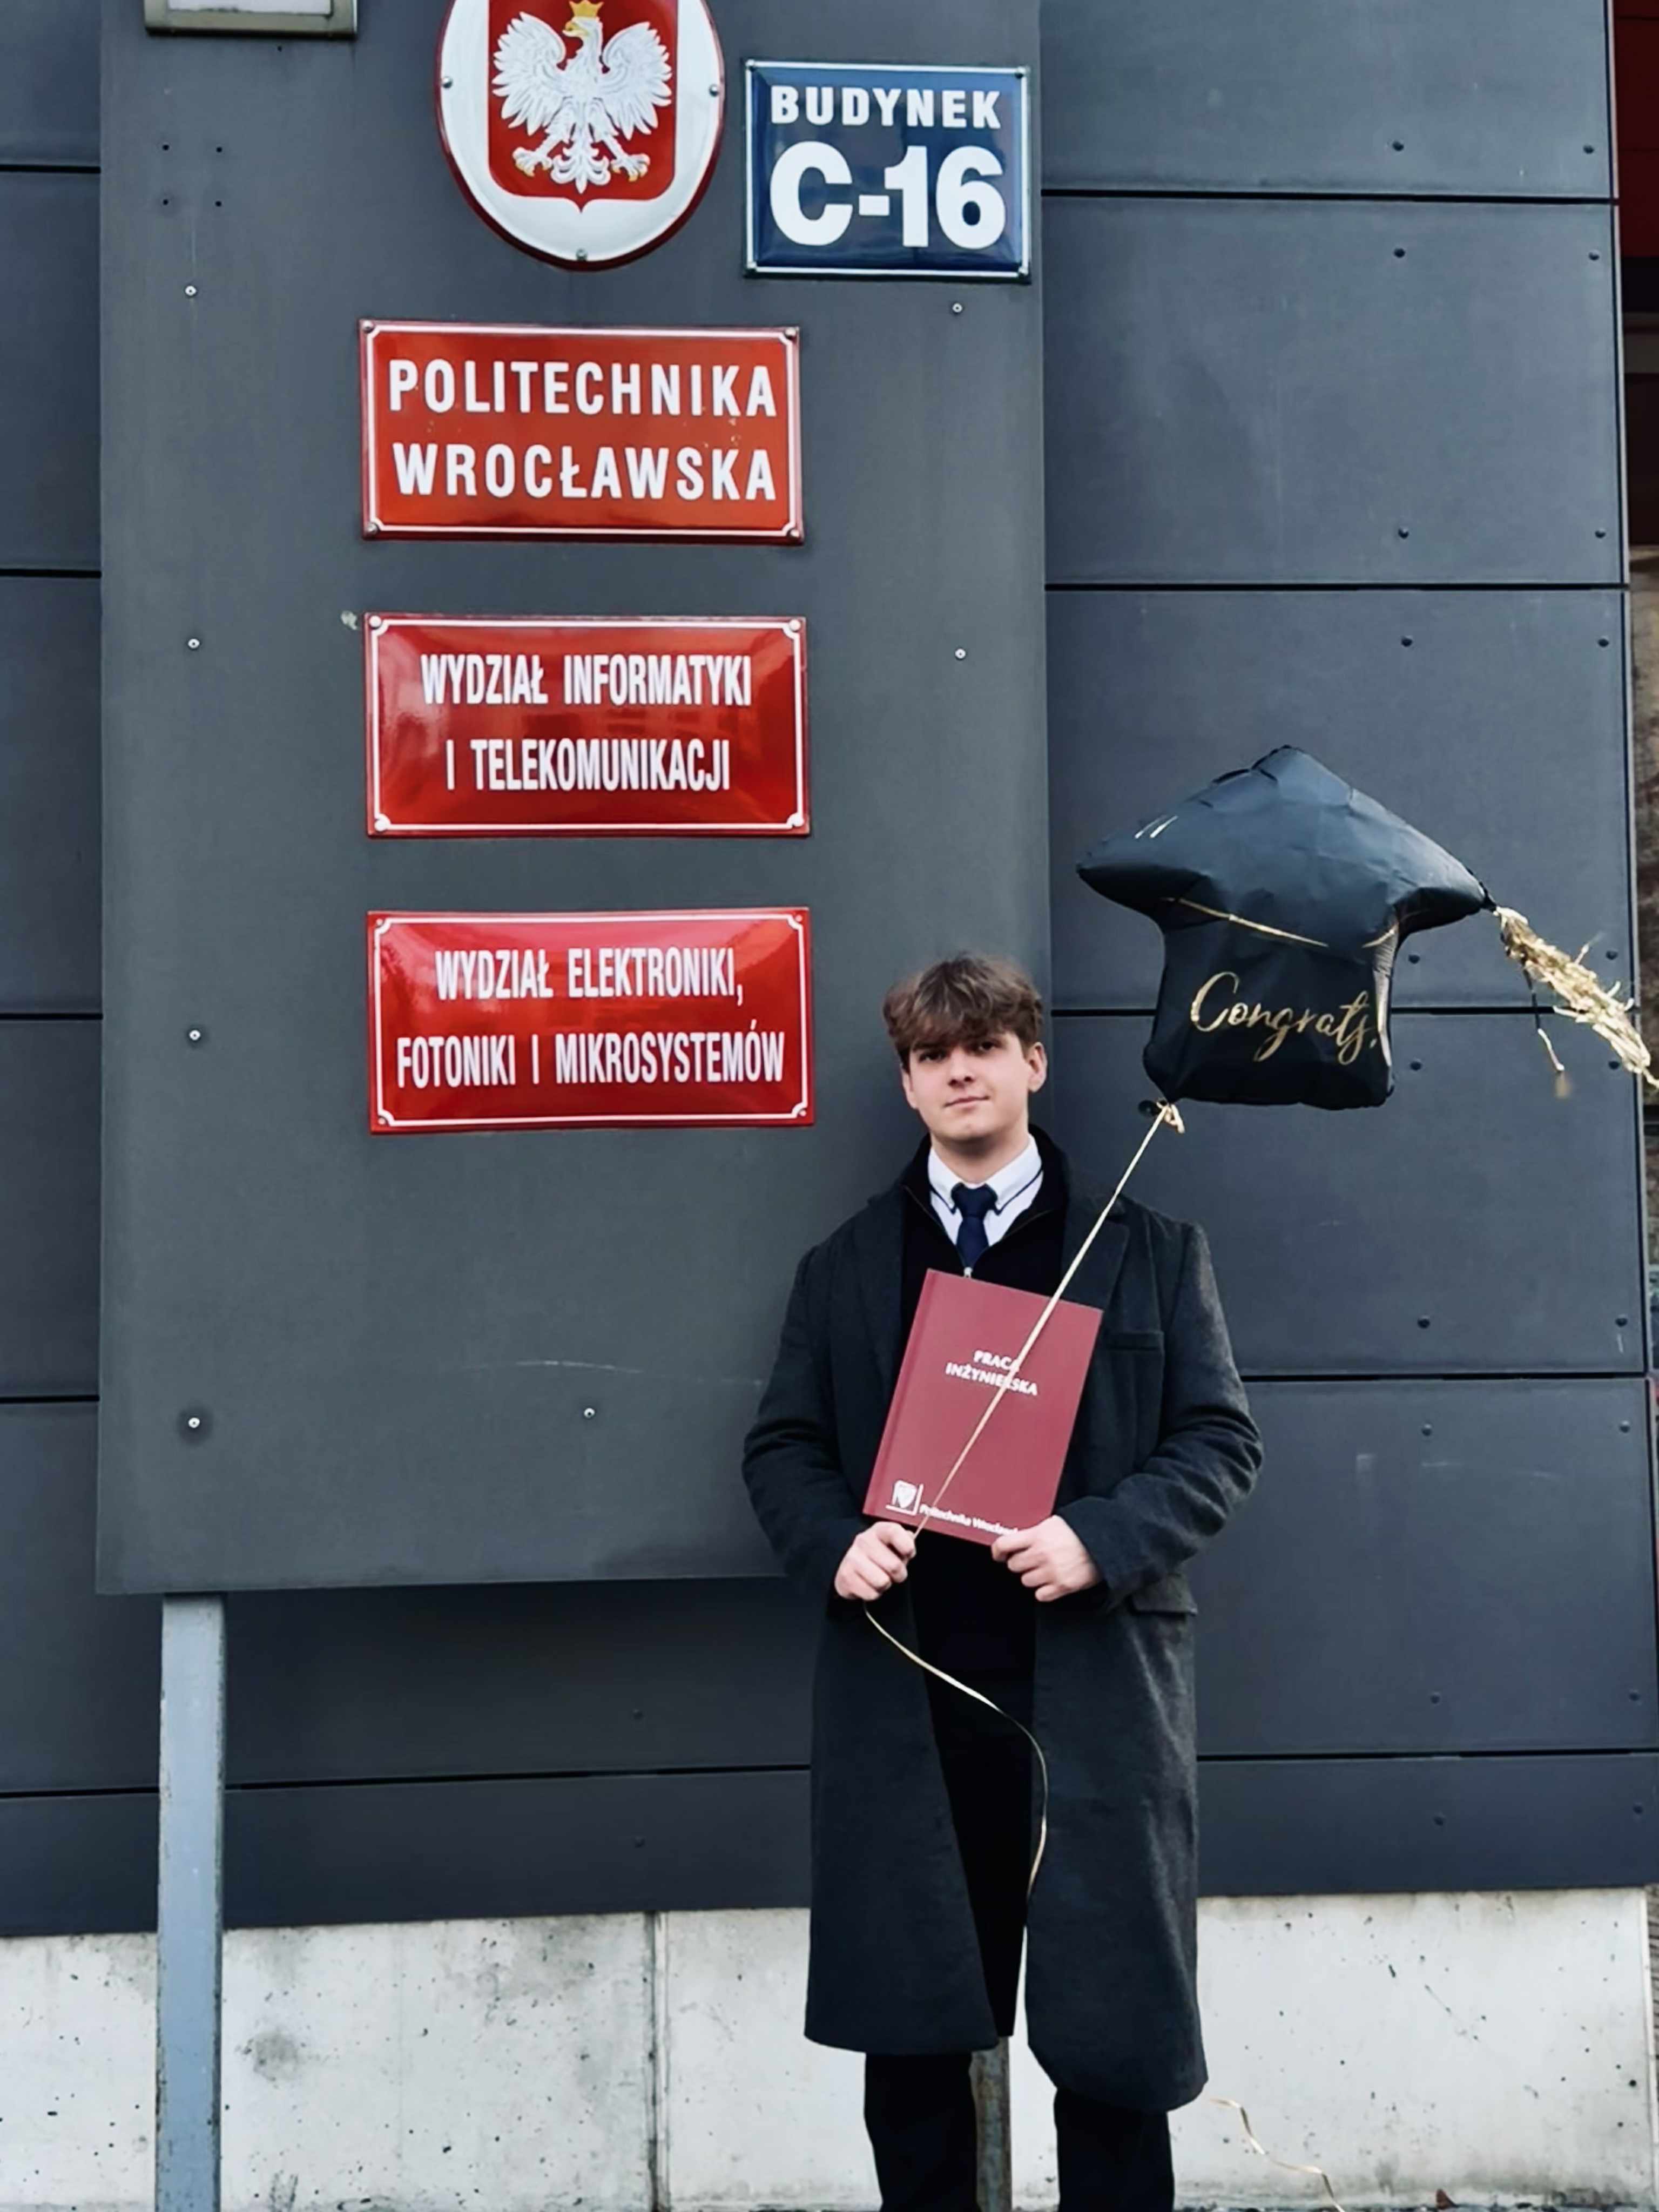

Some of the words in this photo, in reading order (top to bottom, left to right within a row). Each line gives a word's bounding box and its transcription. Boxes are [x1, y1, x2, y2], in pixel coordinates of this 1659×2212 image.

[771, 85, 1001, 130] BUDYNEK
[770, 140, 1006, 249] C-16
[389, 358, 777, 417] POLITECHNIKA
[392, 442, 777, 501] WROCŁAWSKA
[420, 653, 549, 706] WYDZIAŁ
[563, 653, 752, 706] INFORMATYKI
[446, 739, 455, 791] I
[469, 737, 730, 792] TELEKOMUNIKACJI
[434, 948, 554, 1001] WYDZIAŁ
[567, 946, 744, 1007] ELEKTRONIKI,
[396, 1034, 516, 1089] FOTONIKI
[531, 1034, 539, 1085] I
[555, 1019, 785, 1084] MIKROSYSTEMÓW
